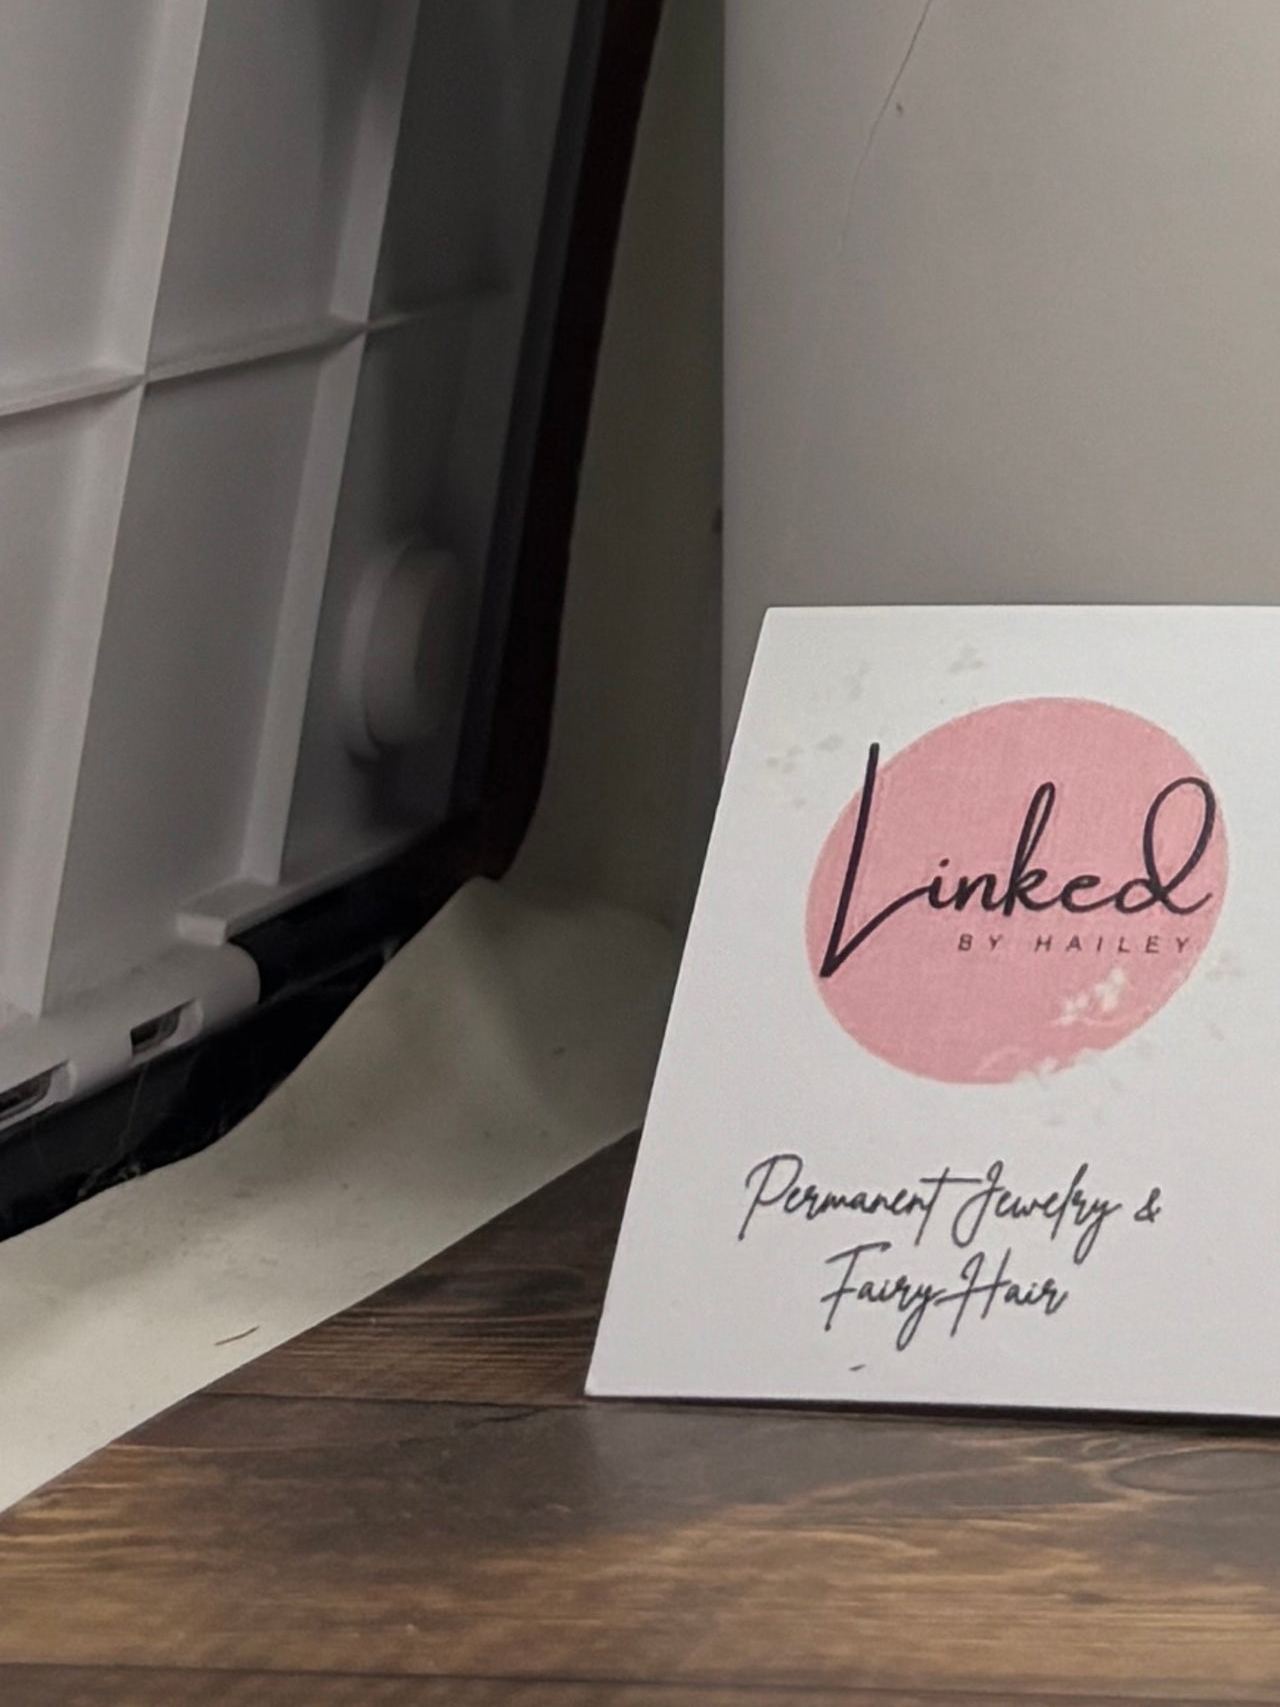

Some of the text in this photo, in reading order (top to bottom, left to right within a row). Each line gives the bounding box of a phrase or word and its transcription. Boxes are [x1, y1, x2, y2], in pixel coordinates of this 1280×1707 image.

[819, 741, 1216, 978] Linked
[957, 933, 1192, 955] BY HAILEY
[738, 1153, 1163, 1265] Permanent Jewelry &
[820, 1242, 1069, 1351] Fairy Hair
